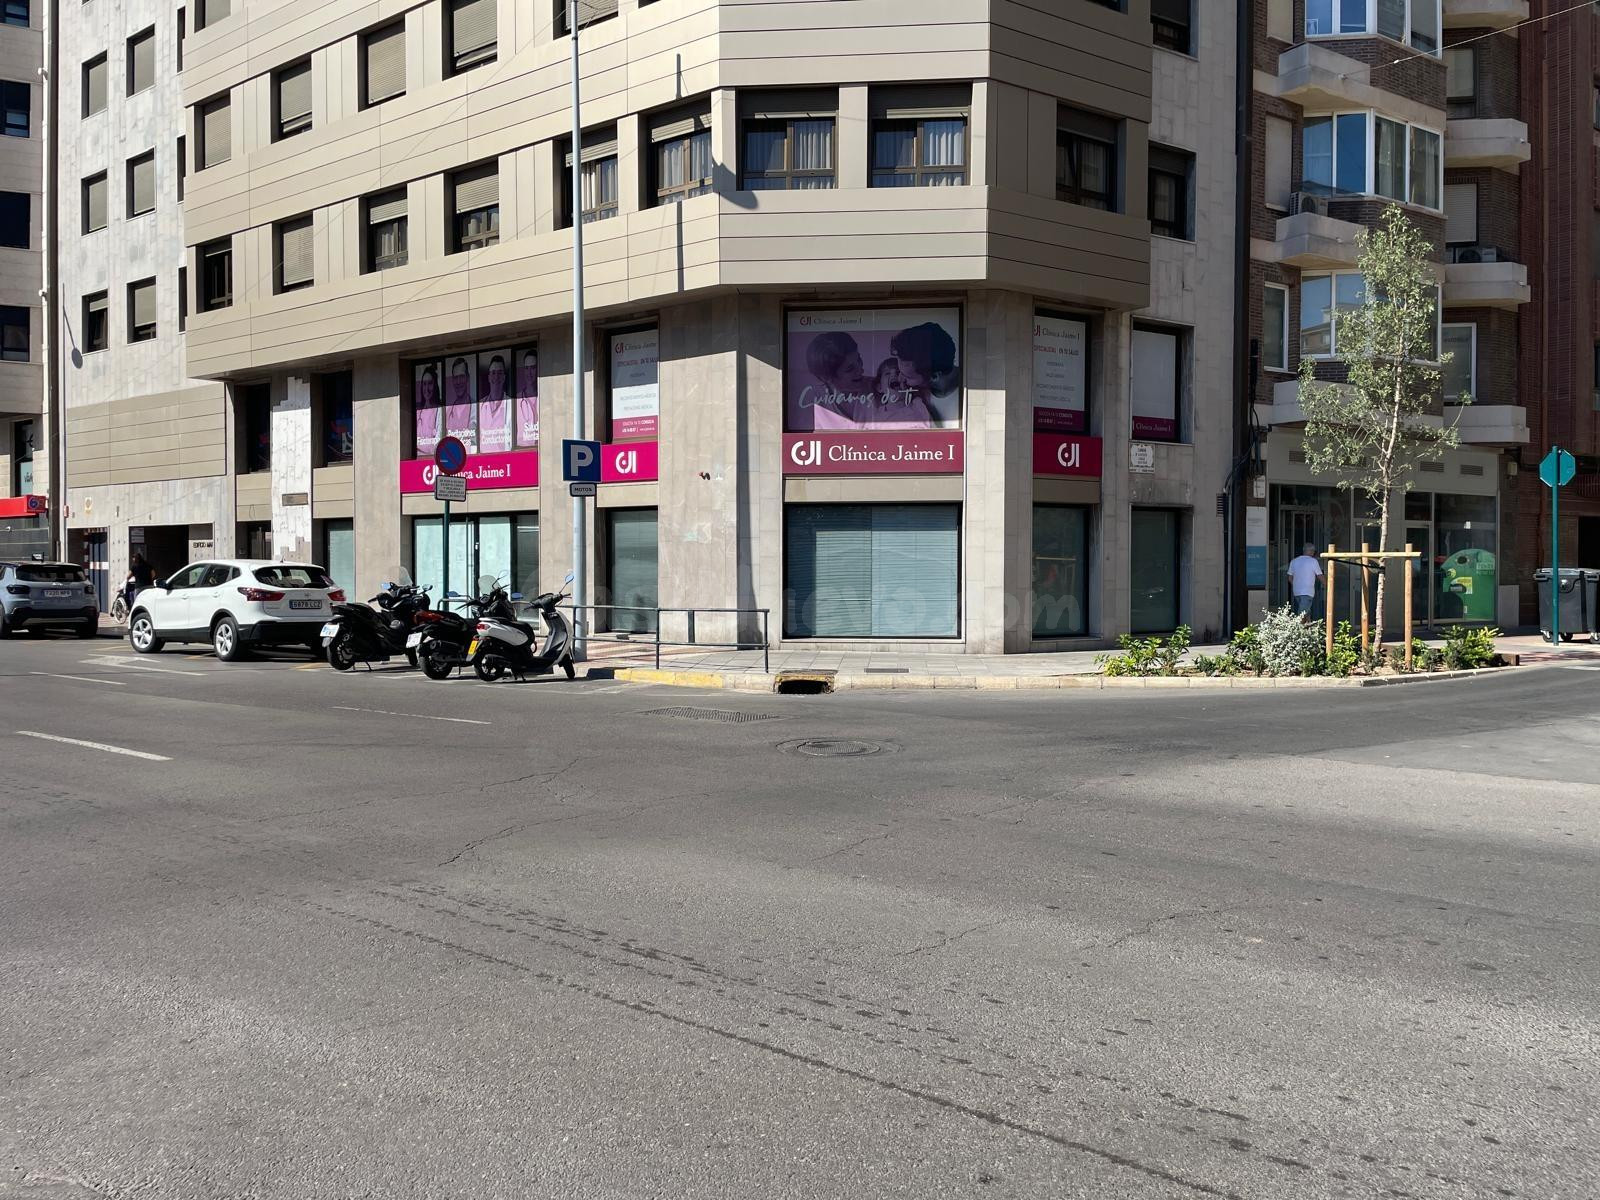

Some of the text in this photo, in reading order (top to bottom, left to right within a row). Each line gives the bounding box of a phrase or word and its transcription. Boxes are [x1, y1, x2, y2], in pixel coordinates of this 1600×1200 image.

[798, 386, 875, 408] Cuidamos
[881, 388, 898, 404] de
[570, 444, 594, 477] P
[828, 445, 887, 461] Clínica
[892, 445, 944, 461] Jaime
[948, 445, 954, 460] I
[475, 465, 504, 479] Jaime
[506, 463, 511, 477] I
